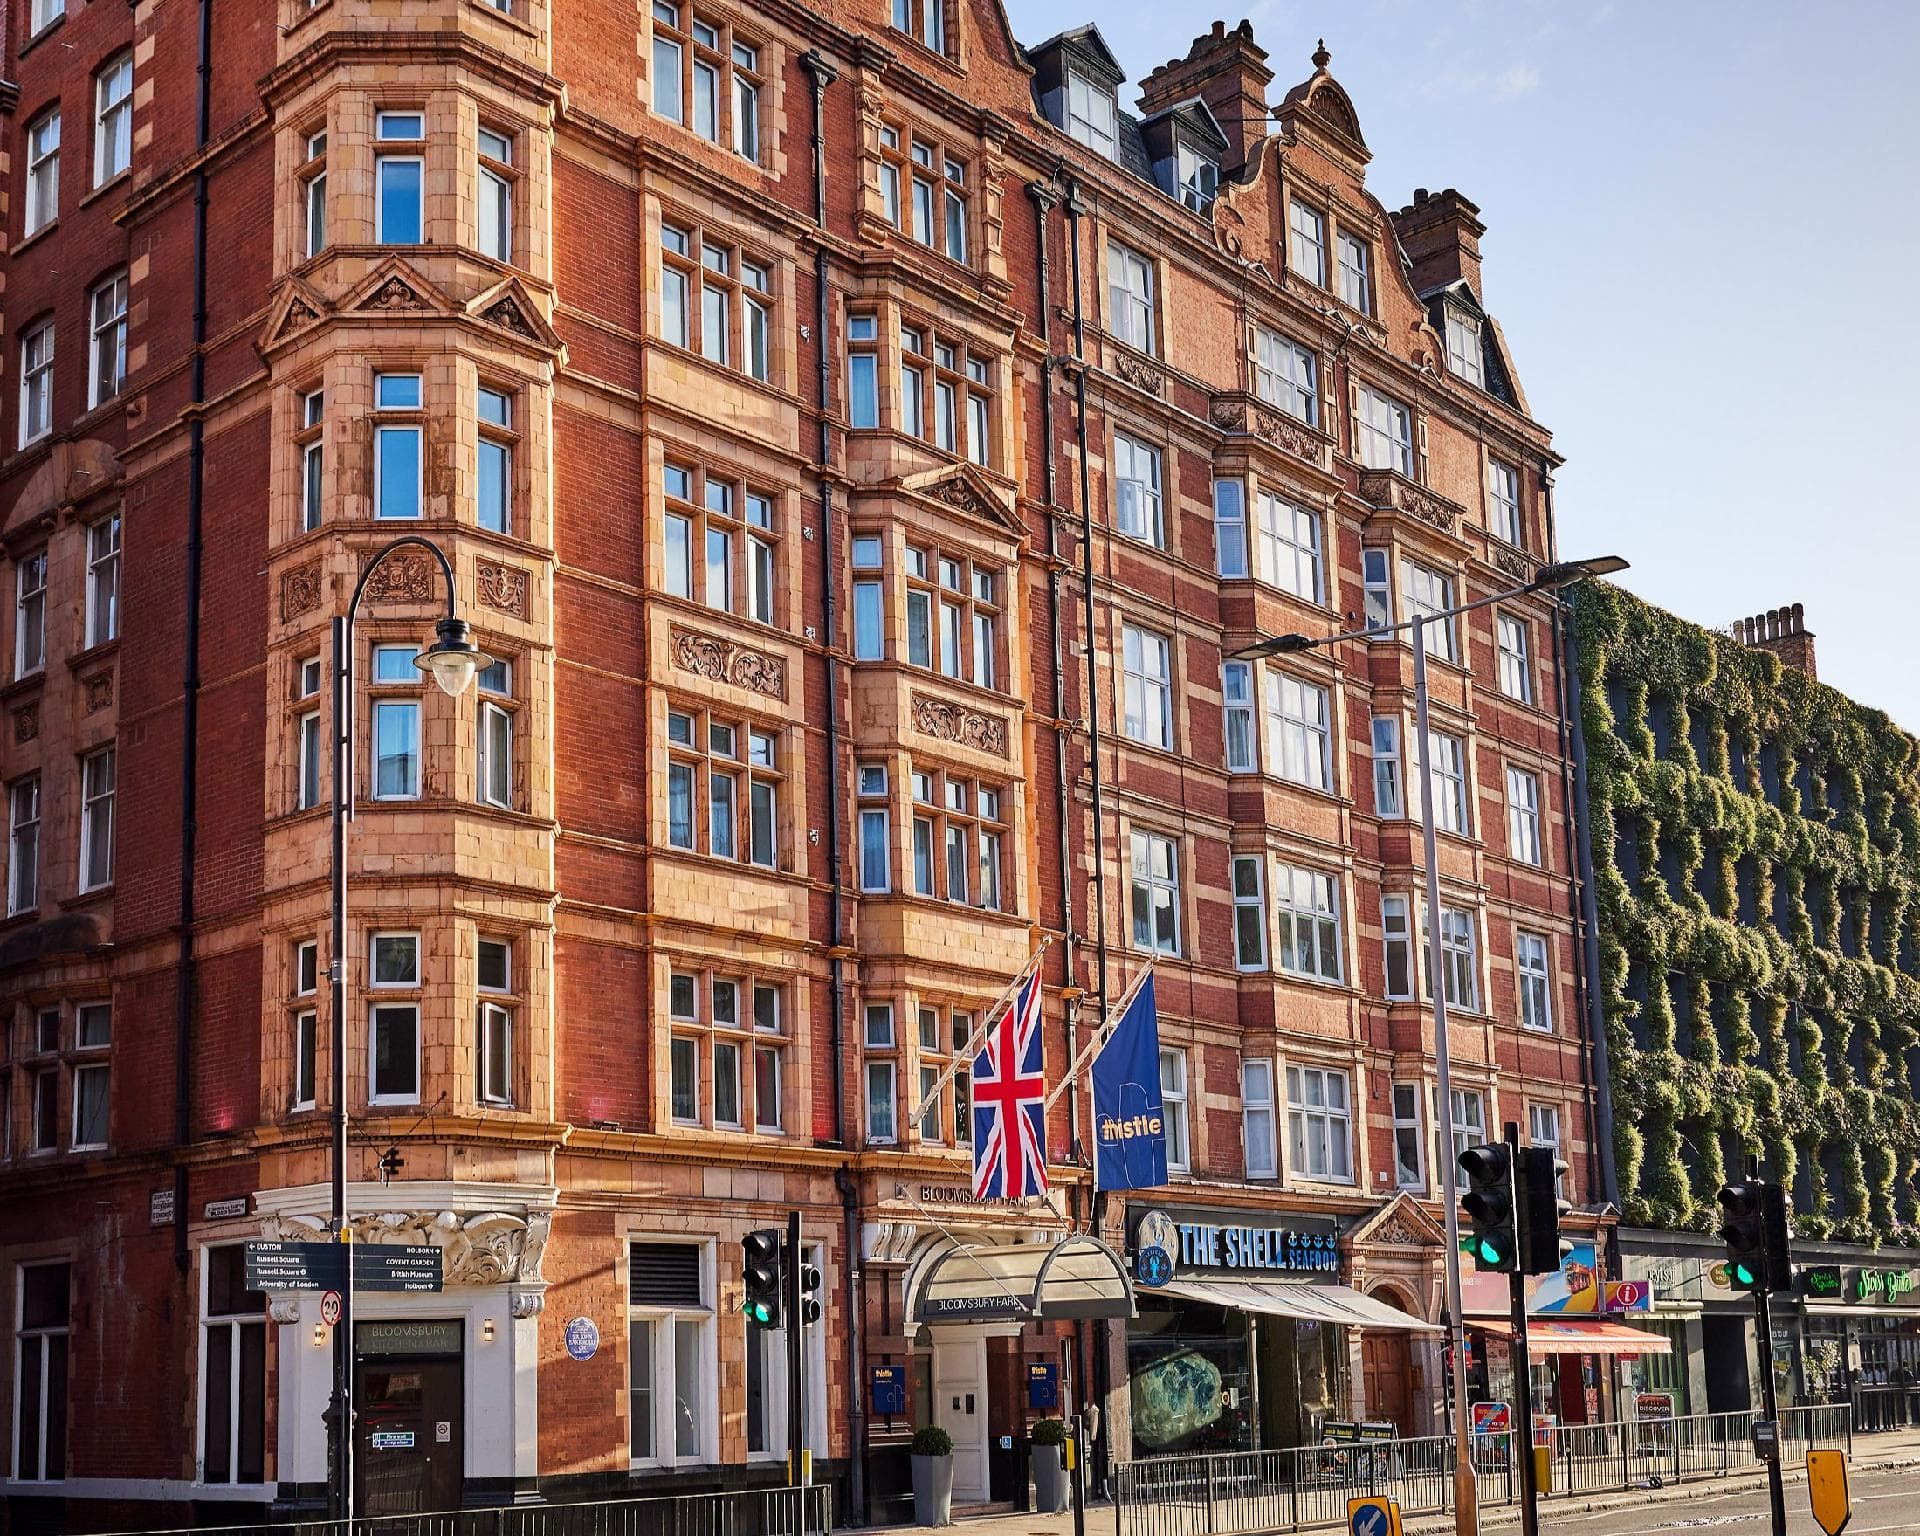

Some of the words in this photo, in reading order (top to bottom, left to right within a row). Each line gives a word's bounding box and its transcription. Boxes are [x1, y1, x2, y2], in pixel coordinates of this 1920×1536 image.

[1101, 1115, 1161, 1140] thistle
[256, 1243, 282, 1251] EUSTON
[406, 1247, 434, 1255] HOLBORN
[1179, 1224, 1221, 1266] THE
[1225, 1227, 1287, 1269] SHELL
[256, 1255, 278, 1263] Russell
[279, 1256, 300, 1264] Square
[1289, 1249, 1337, 1272] SEAFOOD
[256, 1267, 279, 1275] Russell
[279, 1268, 300, 1276] Square
[391, 1270, 410, 1278] British
[410, 1271, 434, 1279] Museum
[257, 1280, 288, 1288] University
[288, 1280, 296, 1288] of
[297, 1280, 319, 1288] London
[405, 1282, 428, 1290] Holborn
[324, 1300, 339, 1315] 20
[938, 1297, 995, 1311] BLOOMSBURY
[996, 1296, 1019, 1307] PARK
[372, 1326, 448, 1337] BLOOMSBURY
